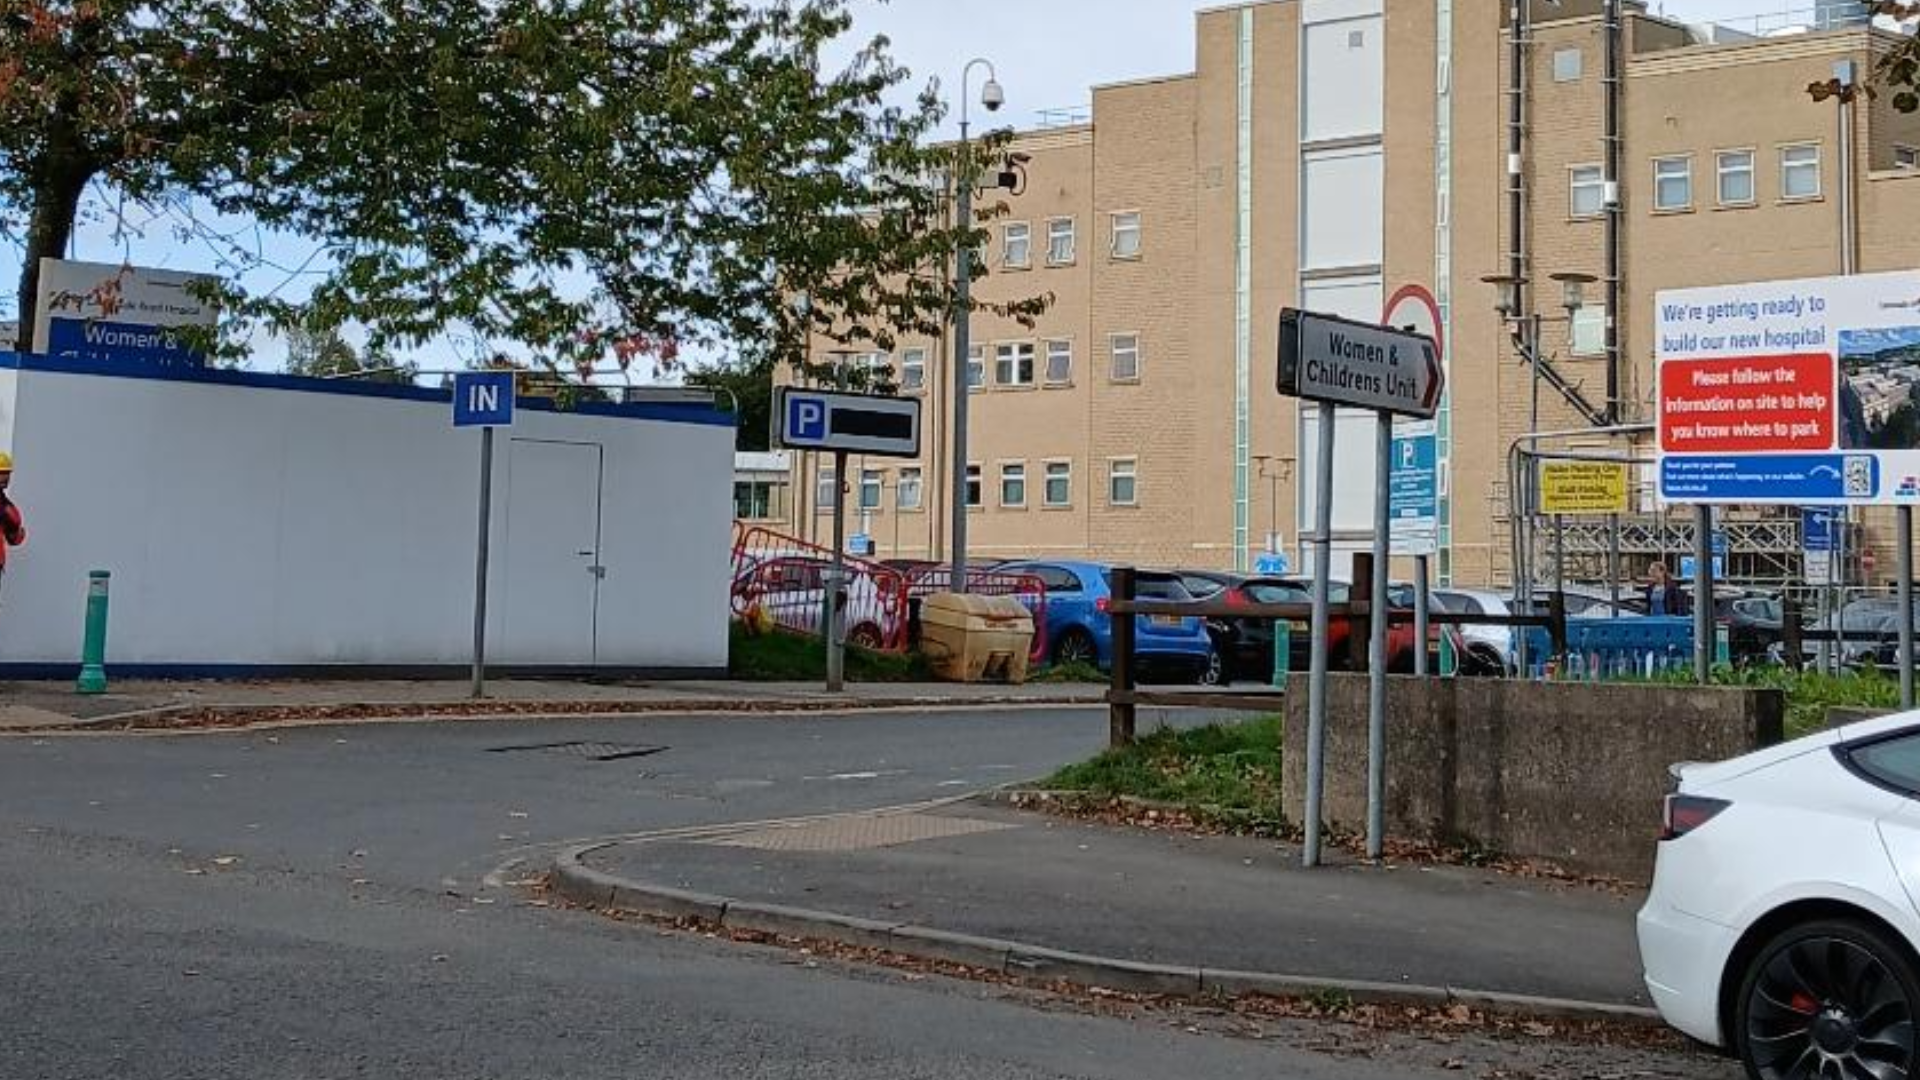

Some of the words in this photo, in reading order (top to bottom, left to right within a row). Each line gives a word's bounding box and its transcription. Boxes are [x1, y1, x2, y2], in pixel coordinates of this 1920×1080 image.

[1662, 304, 1702, 322] We're
[1707, 299, 1759, 324] getting
[1762, 295, 1804, 318] ready
[1809, 296, 1825, 312] to
[84, 325, 159, 348] Women
[164, 330, 178, 350] &
[1329, 332, 1383, 363] Women
[1389, 345, 1399, 367] &
[1663, 333, 1697, 352] build
[1701, 336, 1724, 350] our
[1730, 335, 1760, 349] new
[1765, 325, 1825, 350] hospital
[1306, 359, 1381, 394] Childrens
[1387, 373, 1418, 400] Unit
[1692, 370, 1729, 386] Please
[1732, 368, 1772, 385] follow
[1775, 367, 1796, 382] the
[468, 384, 498, 412] IN
[1666, 395, 1733, 413] information
[1737, 398, 1753, 409] on
[1756, 395, 1777, 410] site
[1781, 395, 1795, 409] to
[1798, 393, 1827, 412] help
[798, 402, 820, 434] P
[1671, 424, 1693, 442] you
[1696, 422, 1729, 438] know
[1733, 420, 1771, 437] where
[1774, 421, 1788, 437] to
[1791, 419, 1820, 441] park
[1403, 441, 1413, 467] P
